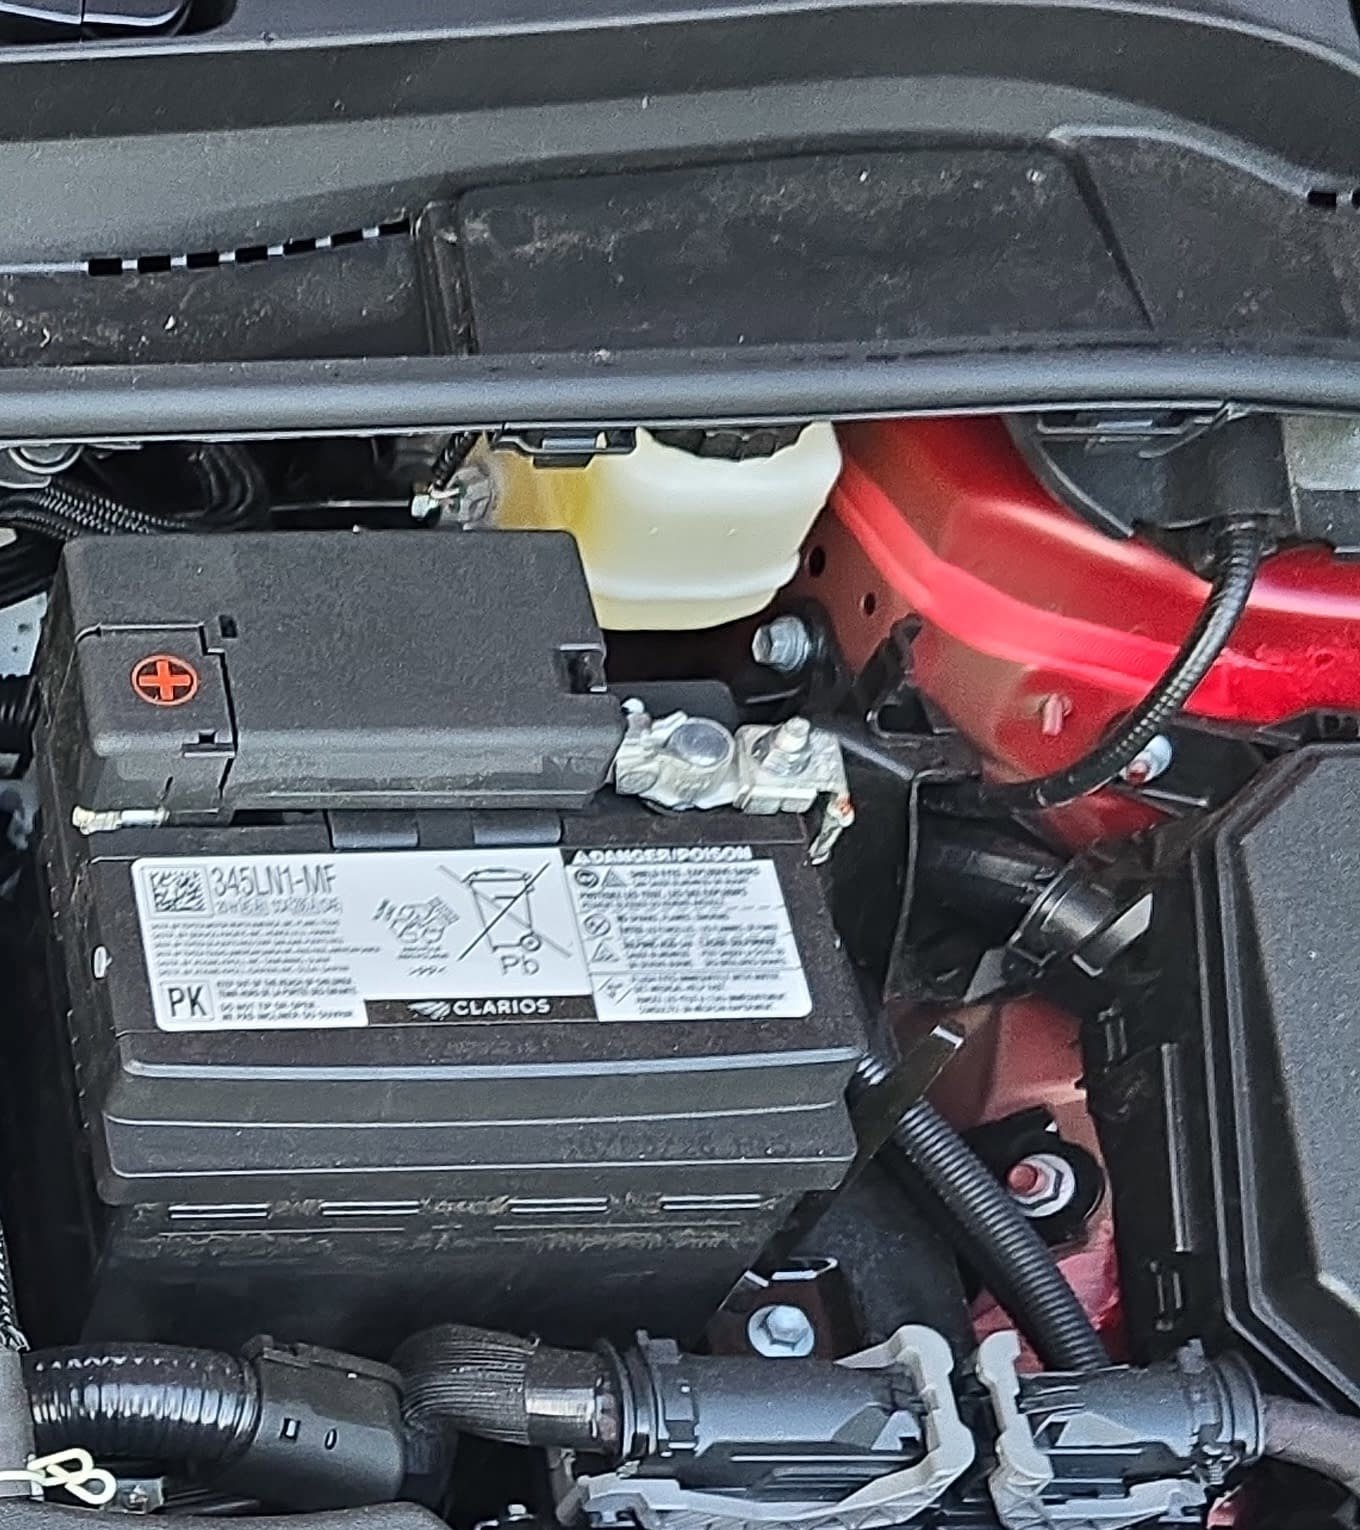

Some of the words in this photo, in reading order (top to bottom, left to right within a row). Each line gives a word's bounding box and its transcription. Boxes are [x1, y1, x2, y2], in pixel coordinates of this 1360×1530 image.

[500, 954, 541, 977] Pb
[168, 985, 208, 1017] PK
[453, 999, 551, 1016] CLARIOS
